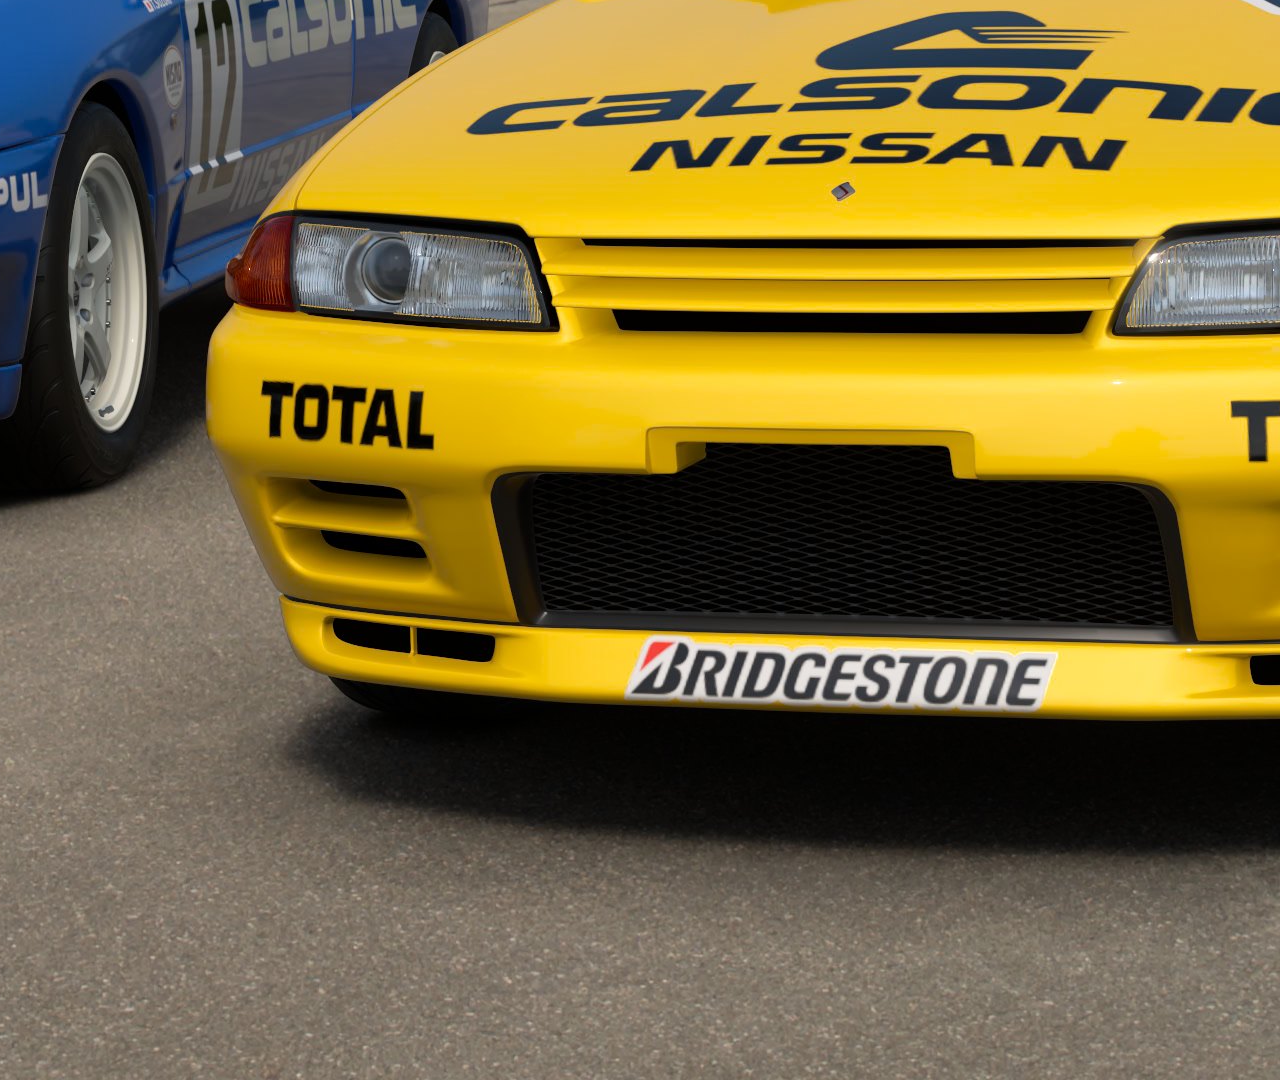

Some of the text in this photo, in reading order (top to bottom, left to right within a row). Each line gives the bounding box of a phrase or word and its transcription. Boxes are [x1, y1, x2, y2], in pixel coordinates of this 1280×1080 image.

[629, 131, 1129, 172] NISSAN
[261, 380, 435, 451] TOTAL
[632, 640, 1049, 708] BRIDGESTONE
